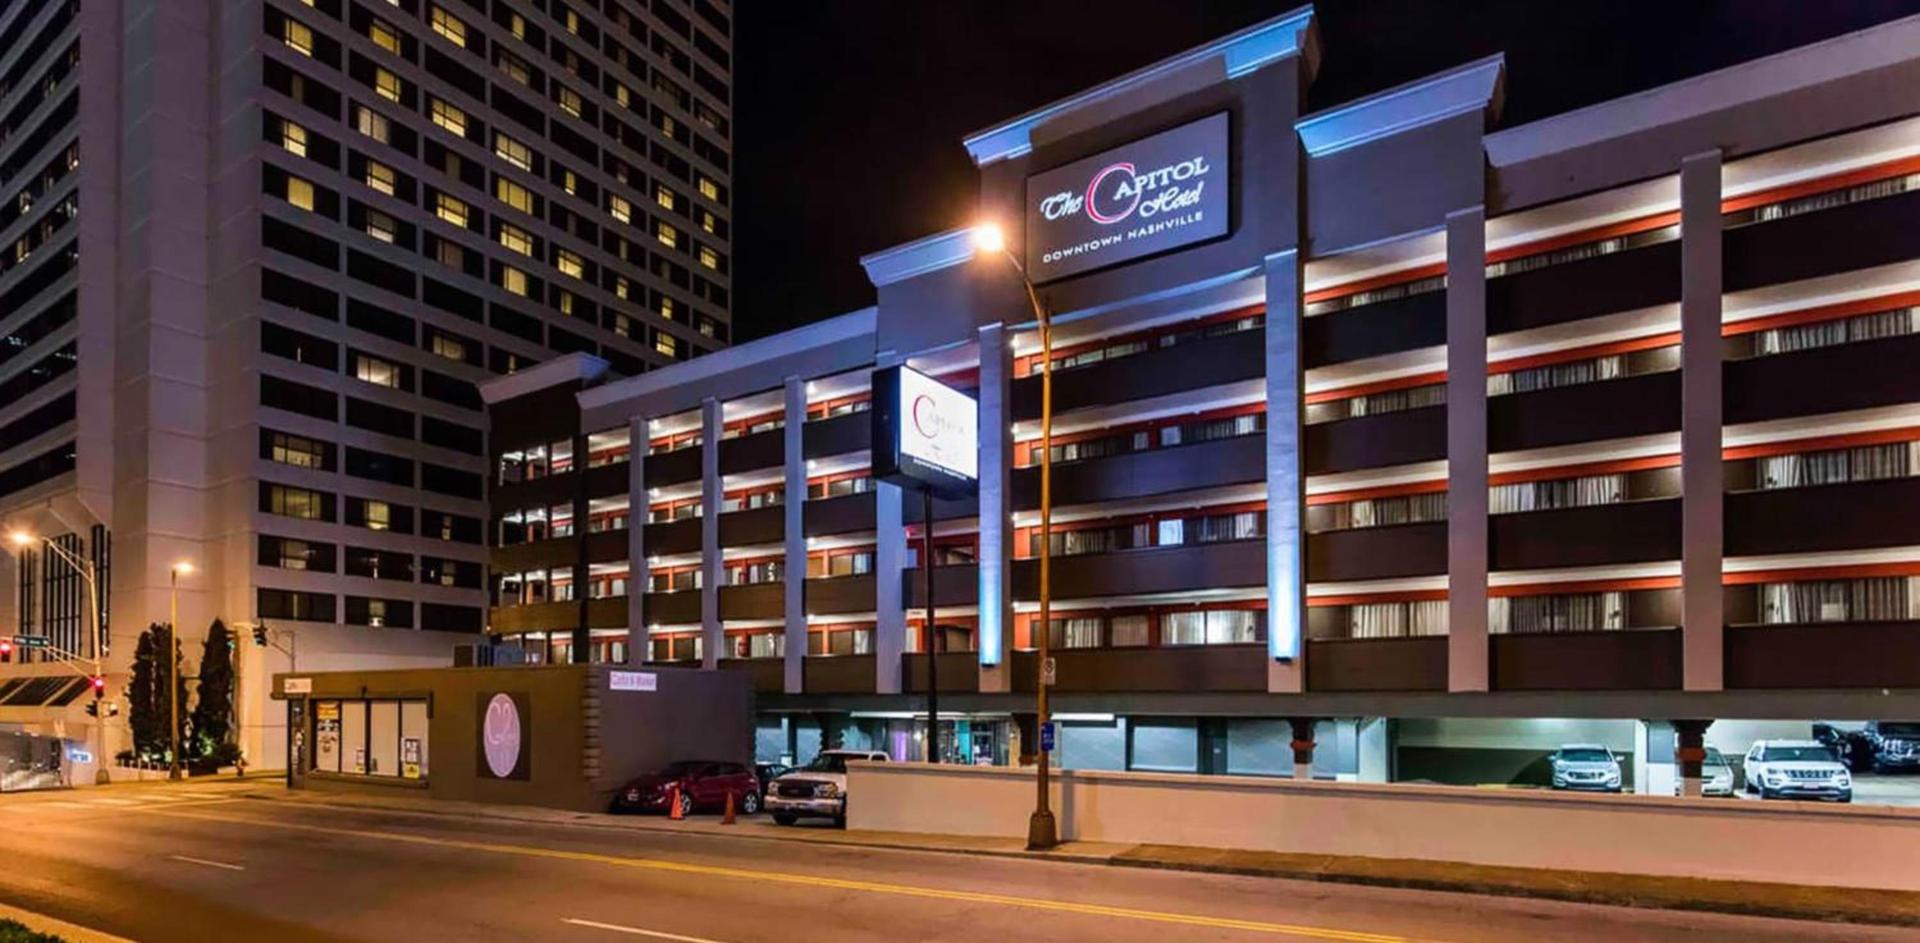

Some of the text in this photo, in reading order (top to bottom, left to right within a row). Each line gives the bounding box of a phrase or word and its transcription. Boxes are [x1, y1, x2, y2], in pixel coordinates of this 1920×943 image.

[1040, 191, 1084, 220] The
[1139, 181, 1204, 218] Hotel
[1042, 211, 1204, 263] DOWNTOWN NASHVILLE
